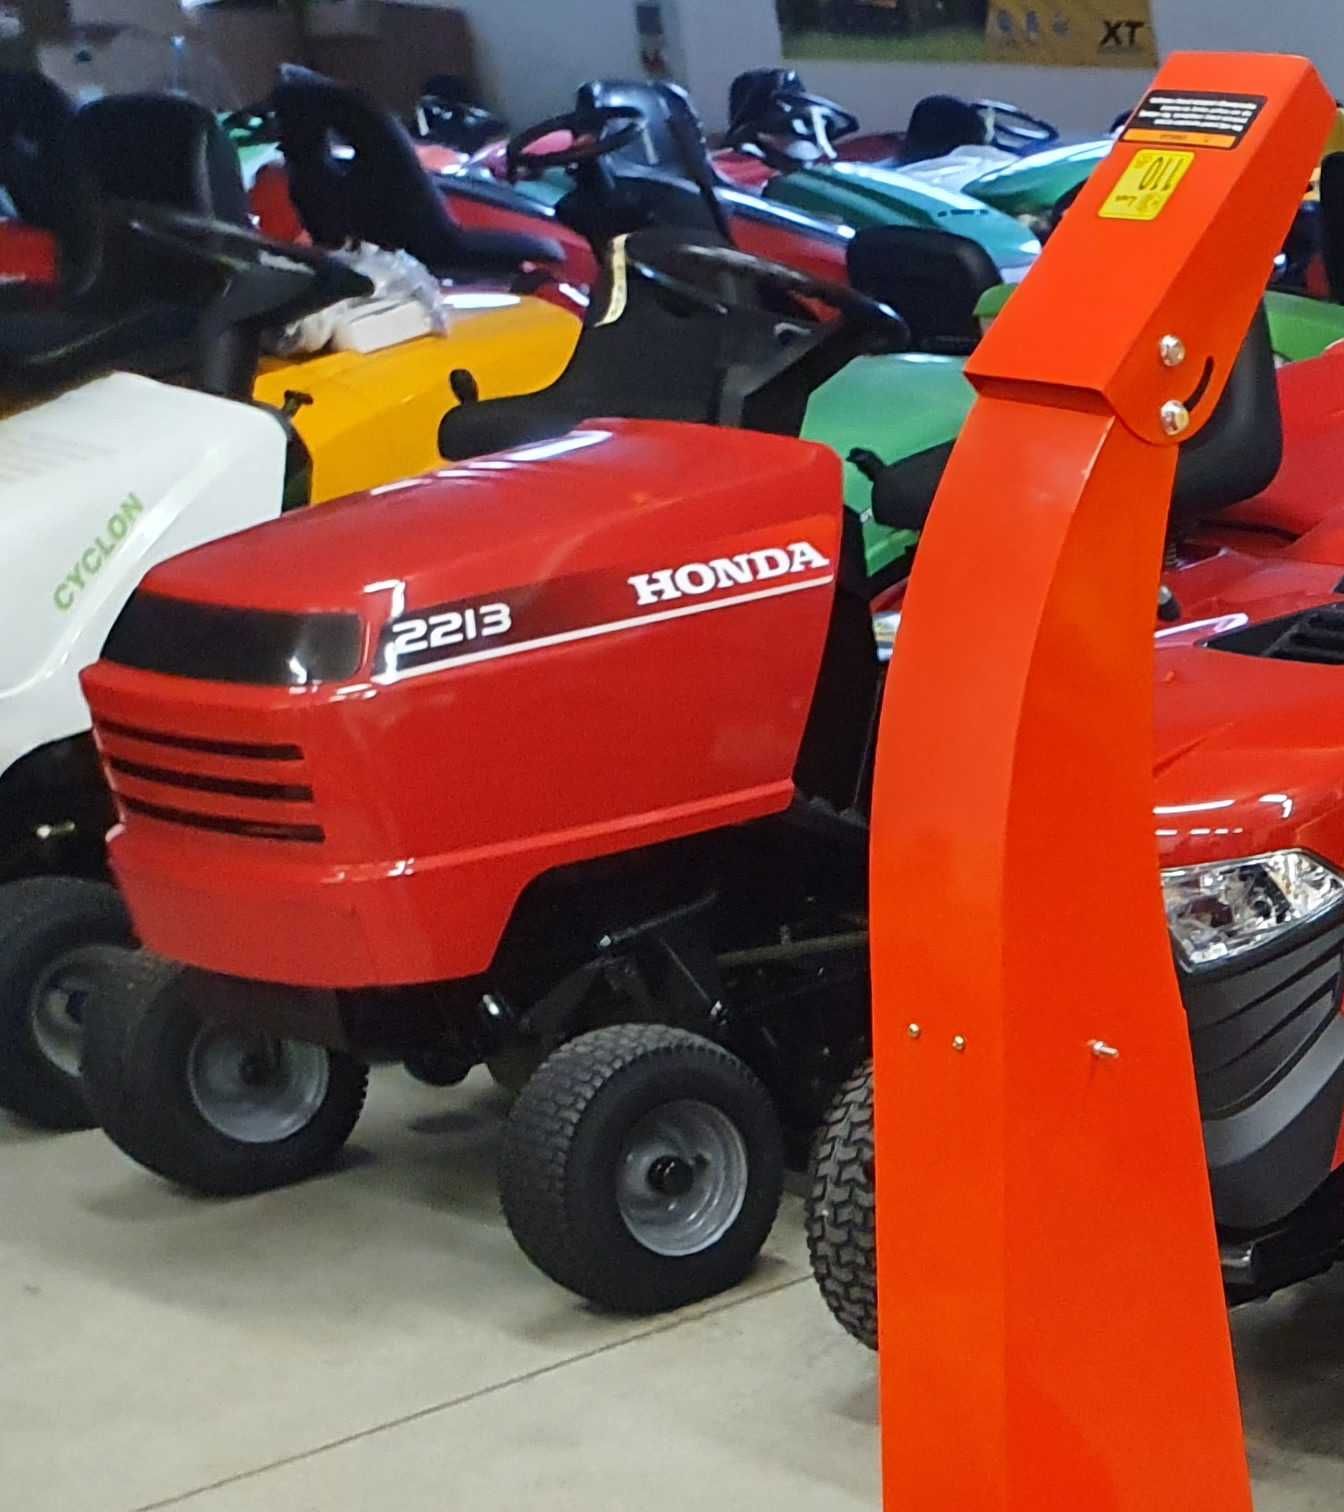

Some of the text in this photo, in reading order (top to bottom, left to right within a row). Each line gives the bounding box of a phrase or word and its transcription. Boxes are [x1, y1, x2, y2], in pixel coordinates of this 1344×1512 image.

[1099, 20, 1145, 47] XT
[54, 491, 144, 612] CYCLON
[627, 541, 830, 606] HONDA
[391, 602, 512, 655] 2213
